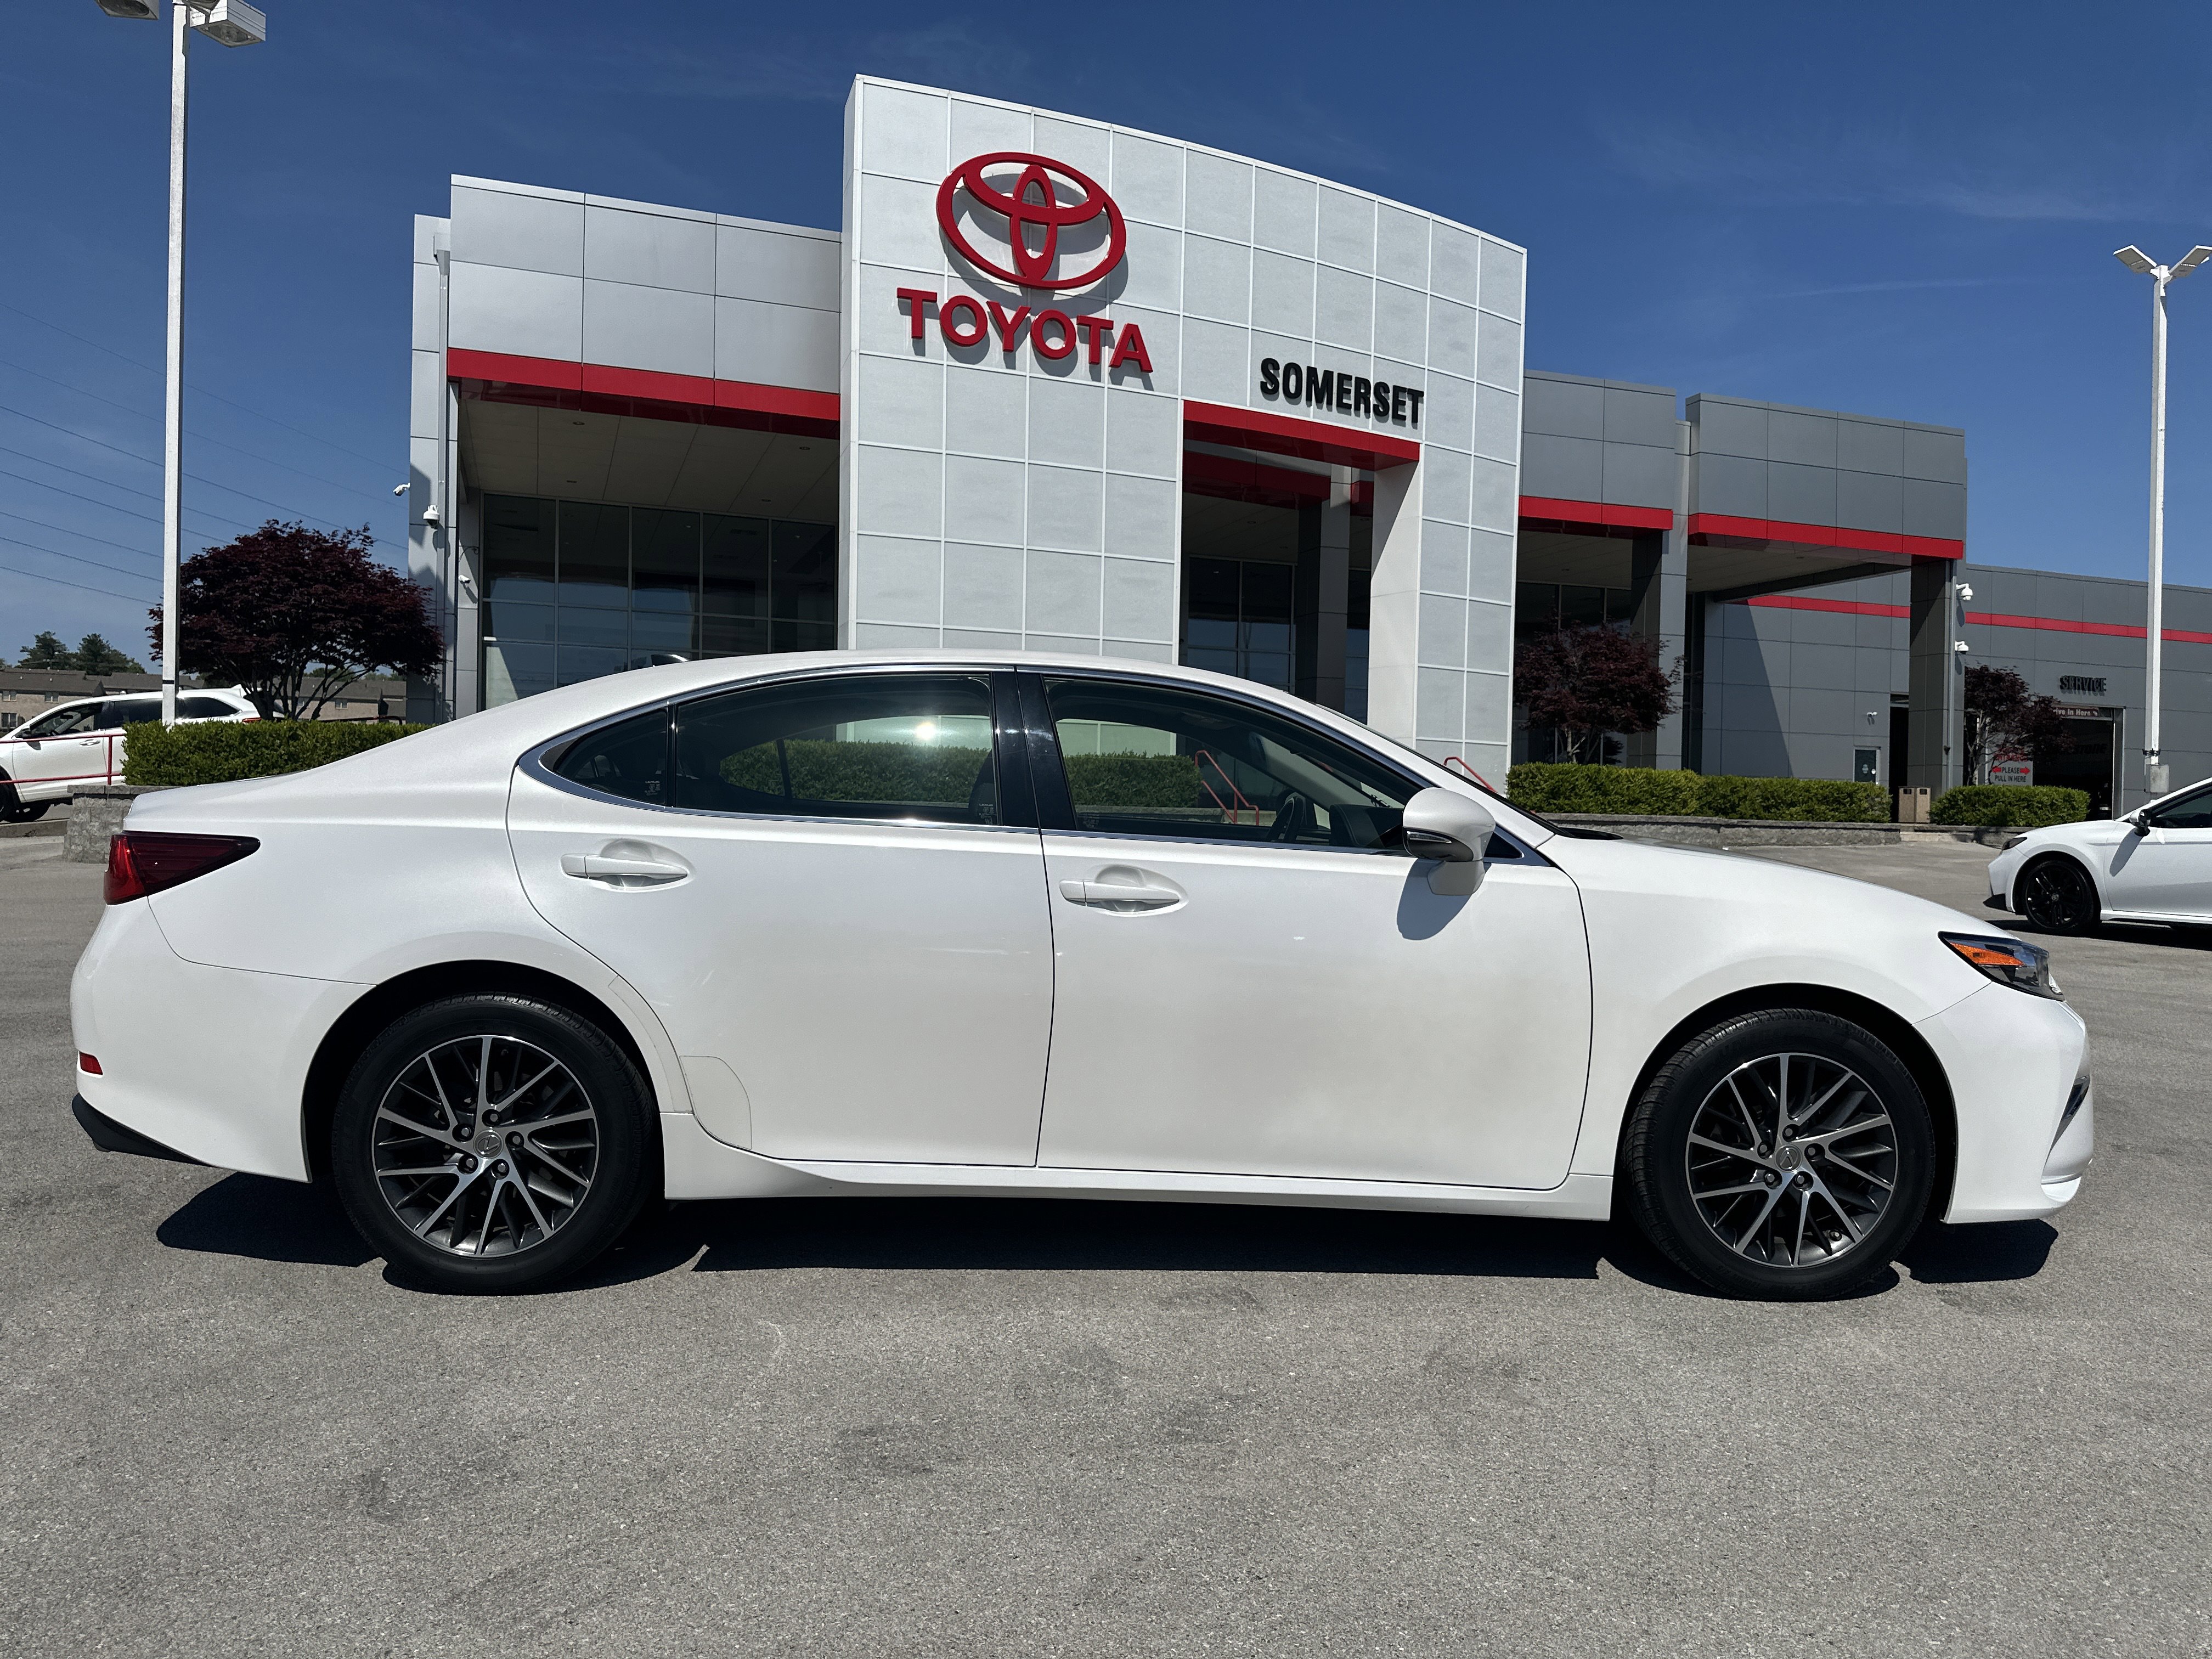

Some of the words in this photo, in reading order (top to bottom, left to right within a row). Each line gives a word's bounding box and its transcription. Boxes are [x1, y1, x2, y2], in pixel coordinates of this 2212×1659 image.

[896, 287, 1153, 373] TOYOTA
[1260, 358, 1424, 424] SOMERSET
[2059, 675, 2107, 692] SERVICE
